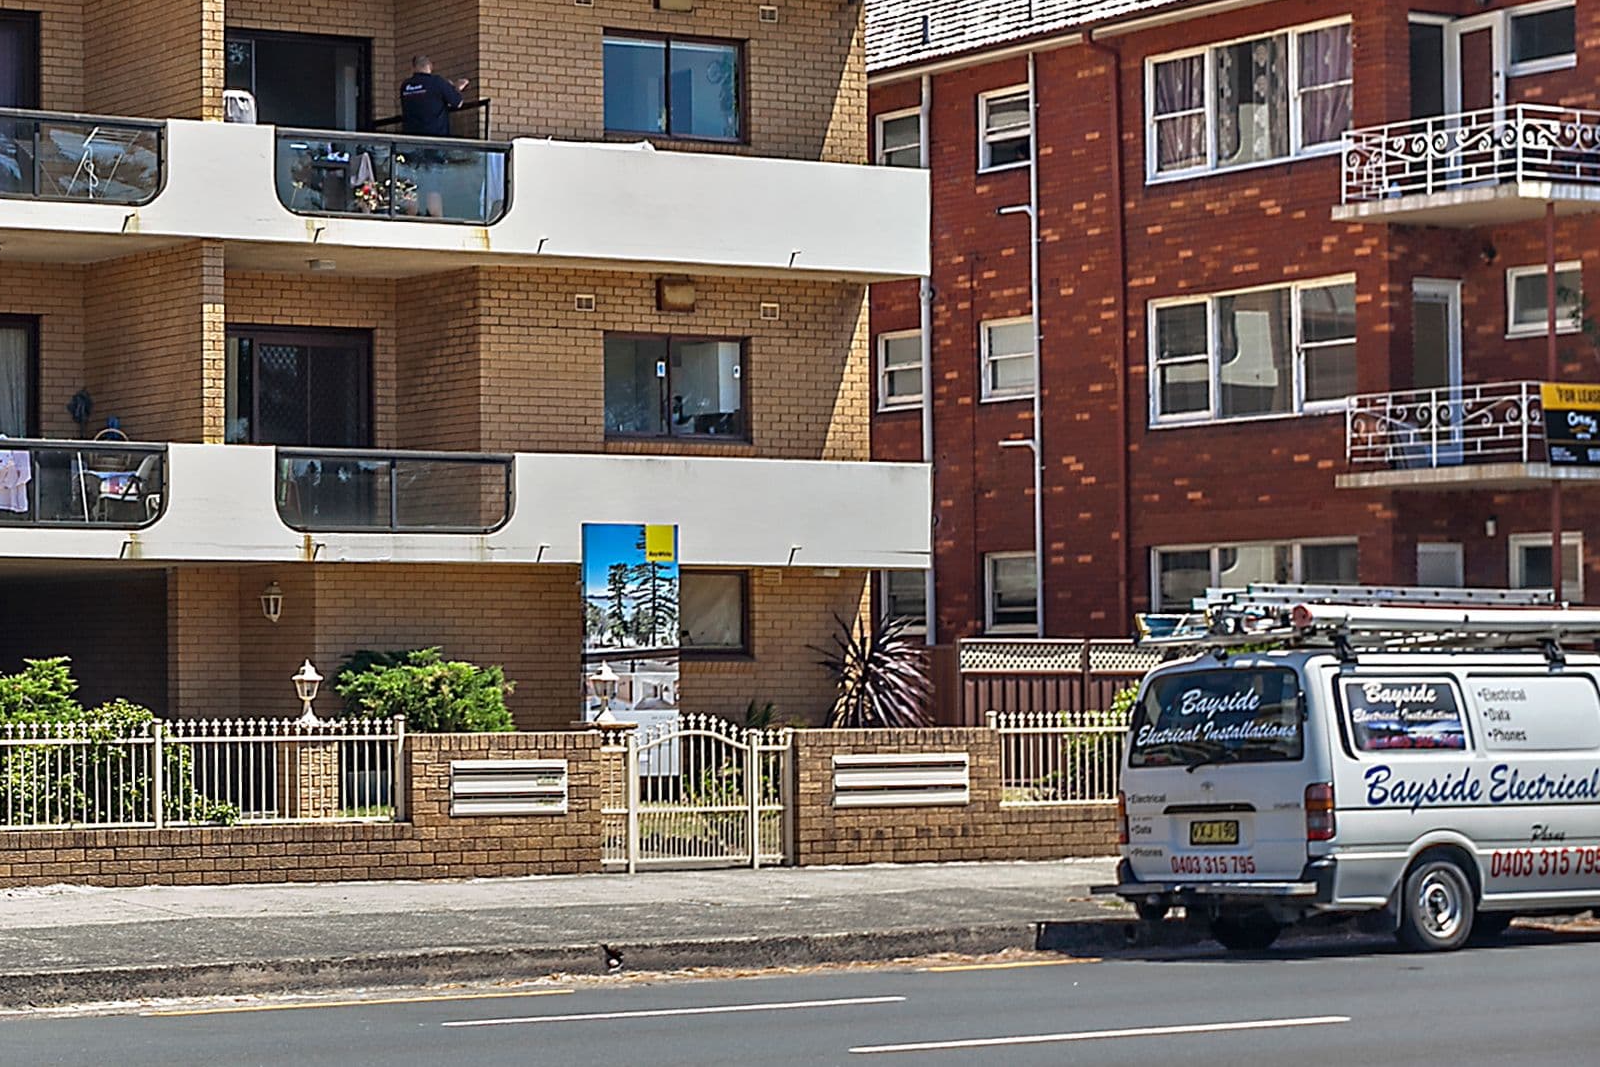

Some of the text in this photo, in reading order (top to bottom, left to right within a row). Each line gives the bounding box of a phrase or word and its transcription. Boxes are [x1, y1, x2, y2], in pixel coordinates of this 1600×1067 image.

[1180, 687, 1260, 719] Bayside
[1362, 682, 1438, 710] Bayside
[1136, 720, 1298, 747] Electrical Installations
[1364, 765, 1483, 815] Bayside
[1489, 764, 1600, 803] Electrical
[1170, 856, 1256, 874] 0403 315 795
[1491, 849, 1534, 877] 0403
[1538, 848, 1570, 876] 315
